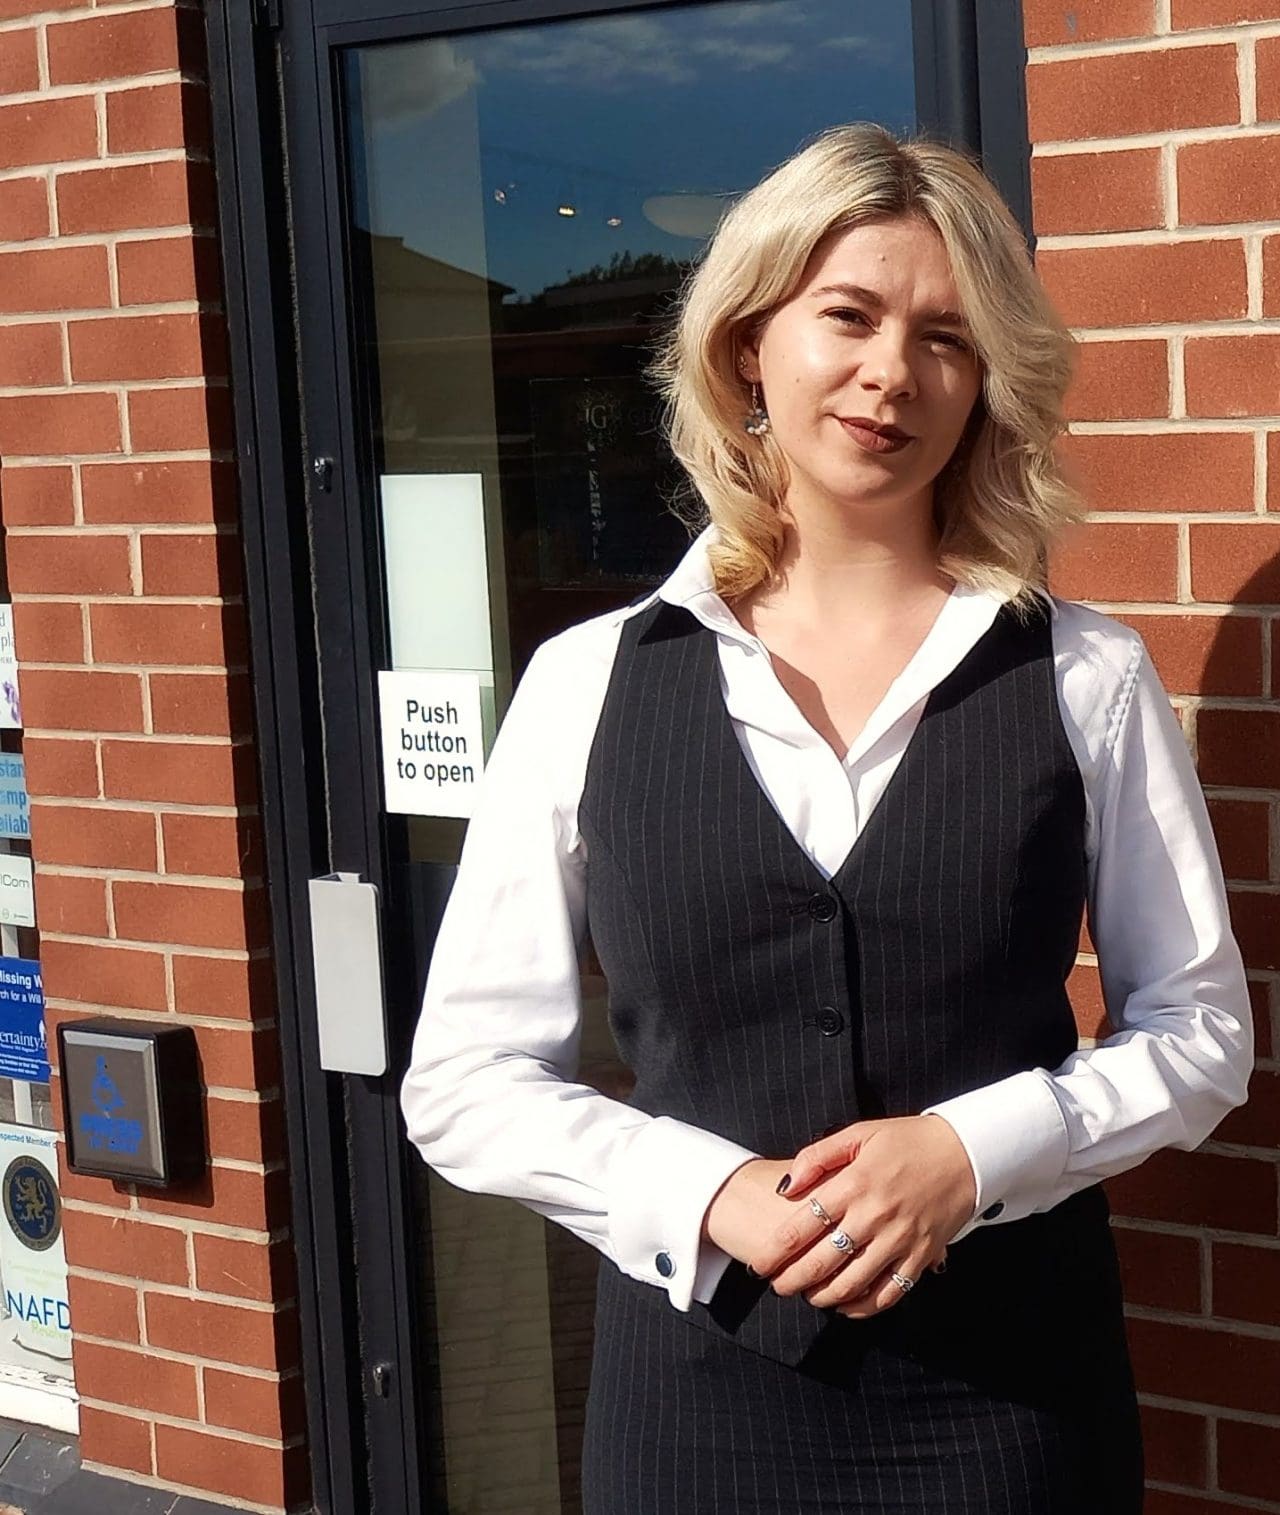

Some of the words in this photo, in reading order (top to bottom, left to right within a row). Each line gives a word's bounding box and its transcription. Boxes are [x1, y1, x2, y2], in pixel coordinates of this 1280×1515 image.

[406, 699, 458, 724] Push
[401, 728, 467, 754] button
[397, 758, 417, 779] to
[424, 762, 474, 787] open
[6, 1289, 72, 1330] NAFD
